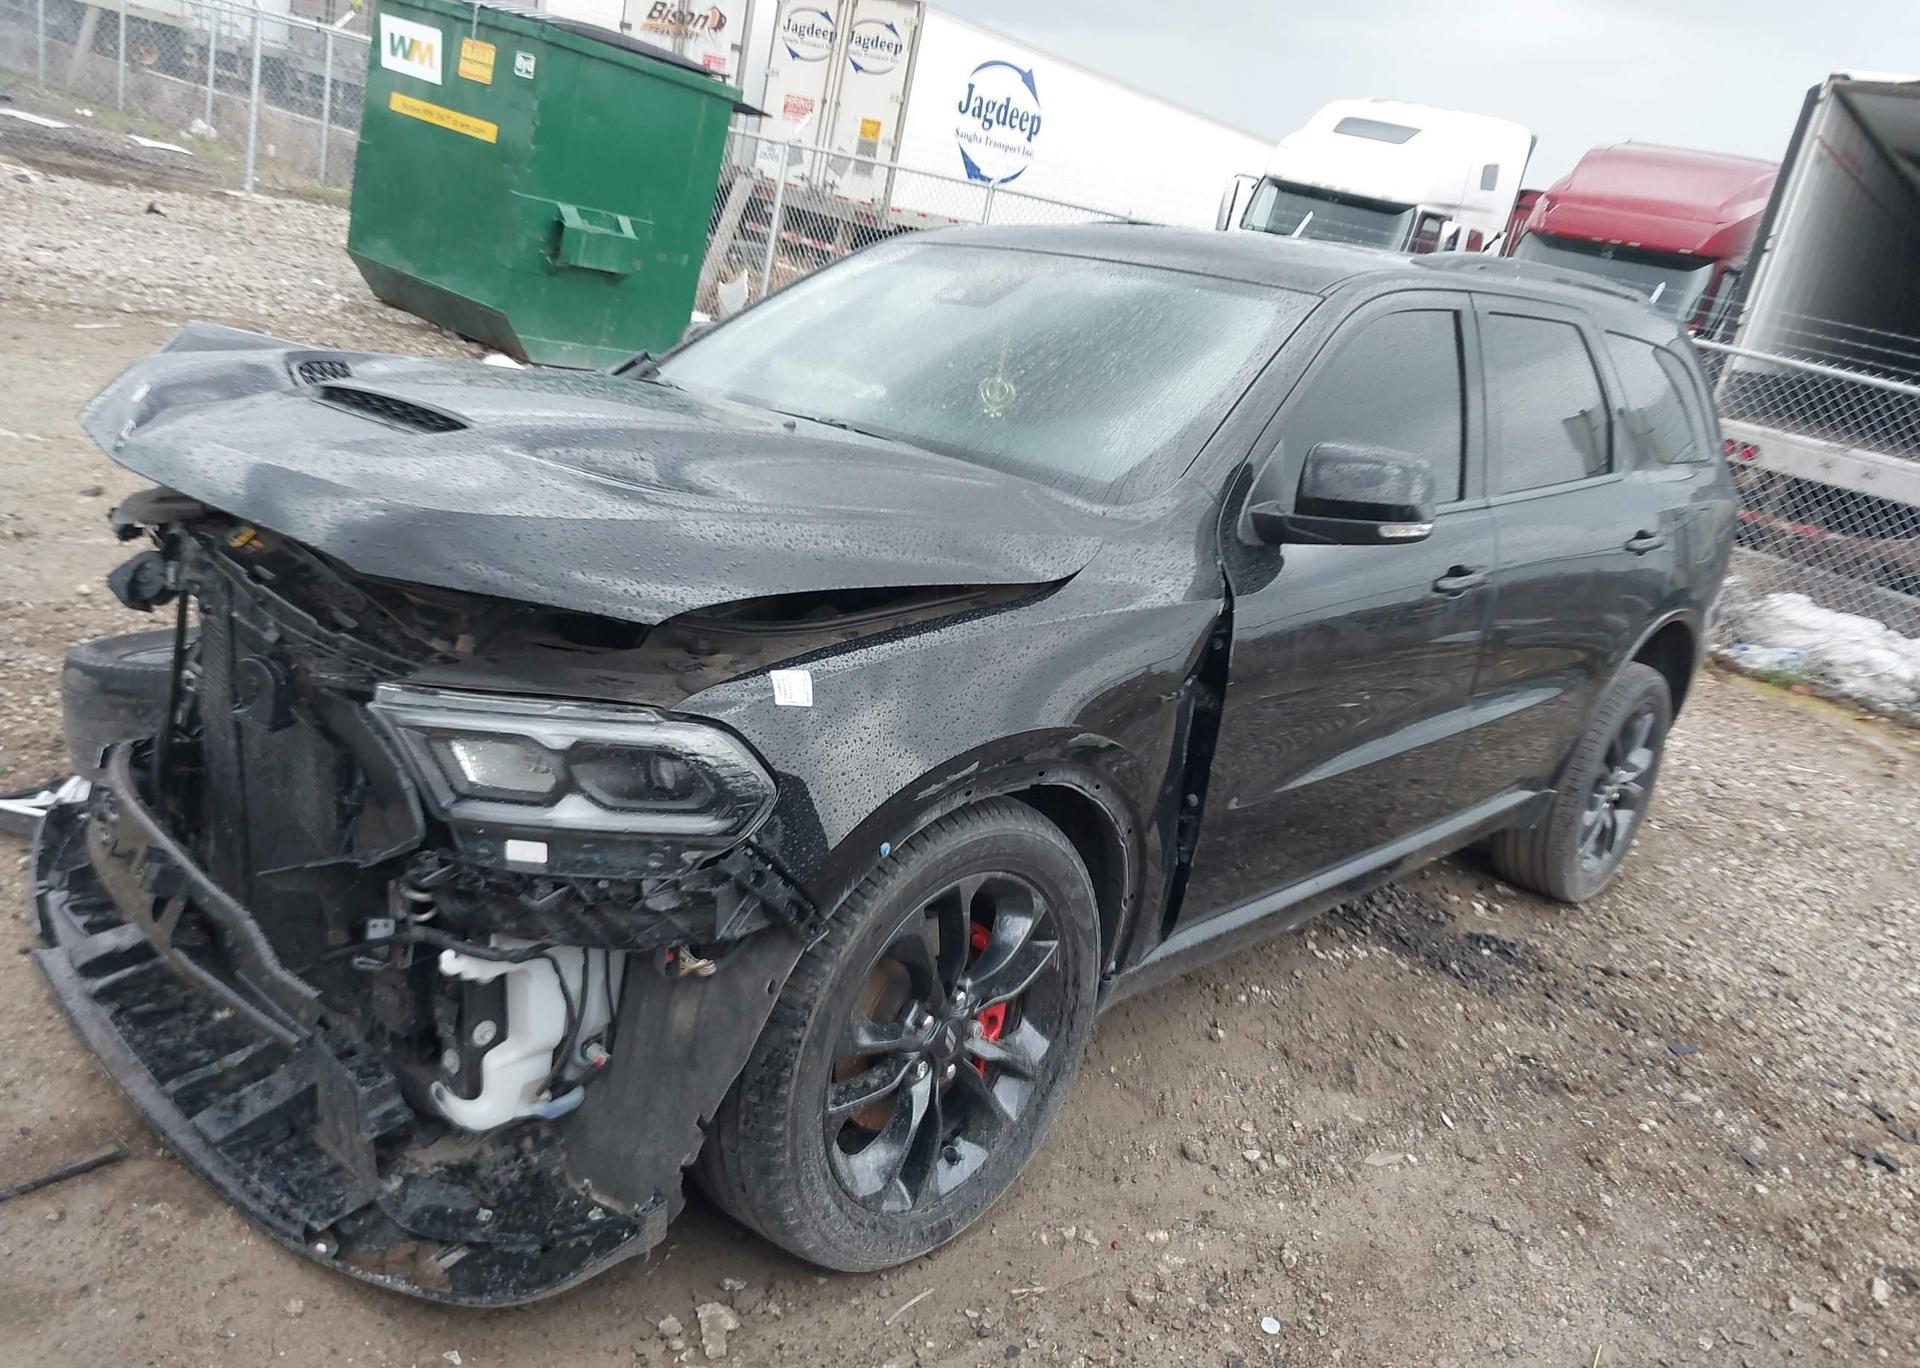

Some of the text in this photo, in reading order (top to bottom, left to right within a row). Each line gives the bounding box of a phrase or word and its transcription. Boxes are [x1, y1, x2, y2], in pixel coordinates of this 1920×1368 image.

[646, 1, 709, 30] Bison
[783, 18, 838, 43] Jagdeep
[848, 30, 903, 56] Jagdeep
[389, 31, 435, 70] WM
[958, 83, 1042, 142] Jagdeep
[955, 127, 983, 144] Sangha
